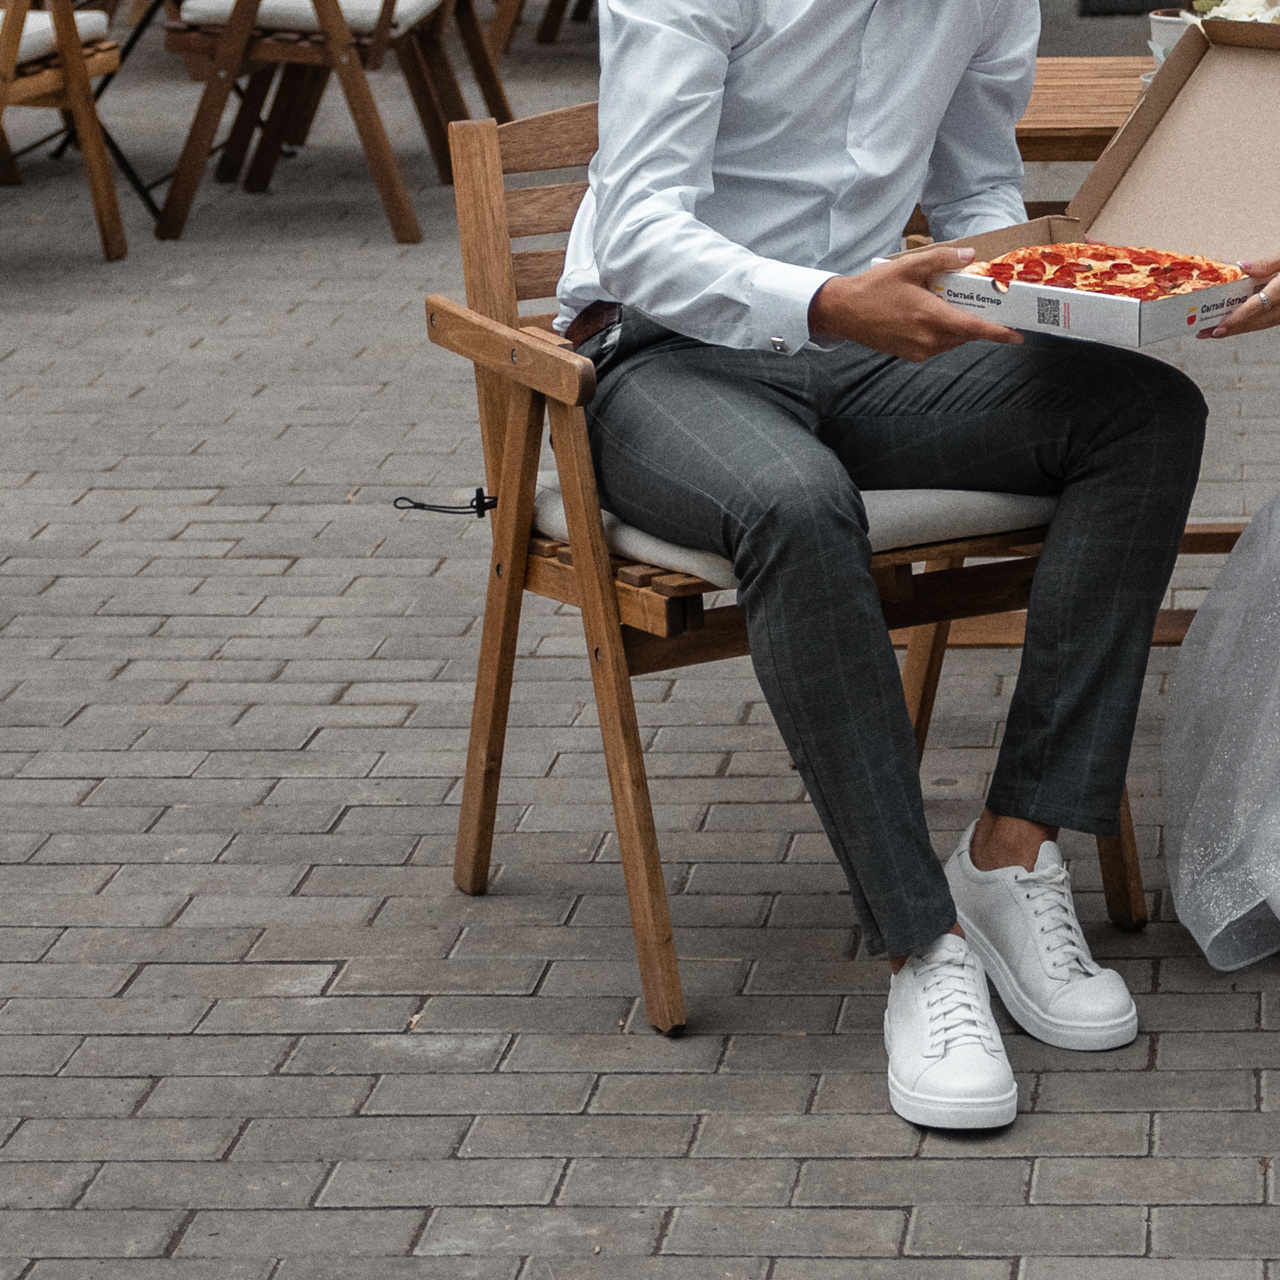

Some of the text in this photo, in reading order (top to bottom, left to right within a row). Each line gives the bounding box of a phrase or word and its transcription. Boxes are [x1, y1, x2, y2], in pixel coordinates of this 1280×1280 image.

[946, 289, 975, 302] Сытый
[975, 293, 1002, 306] батыр
[1201, 295, 1248, 314] Сытый батыр
